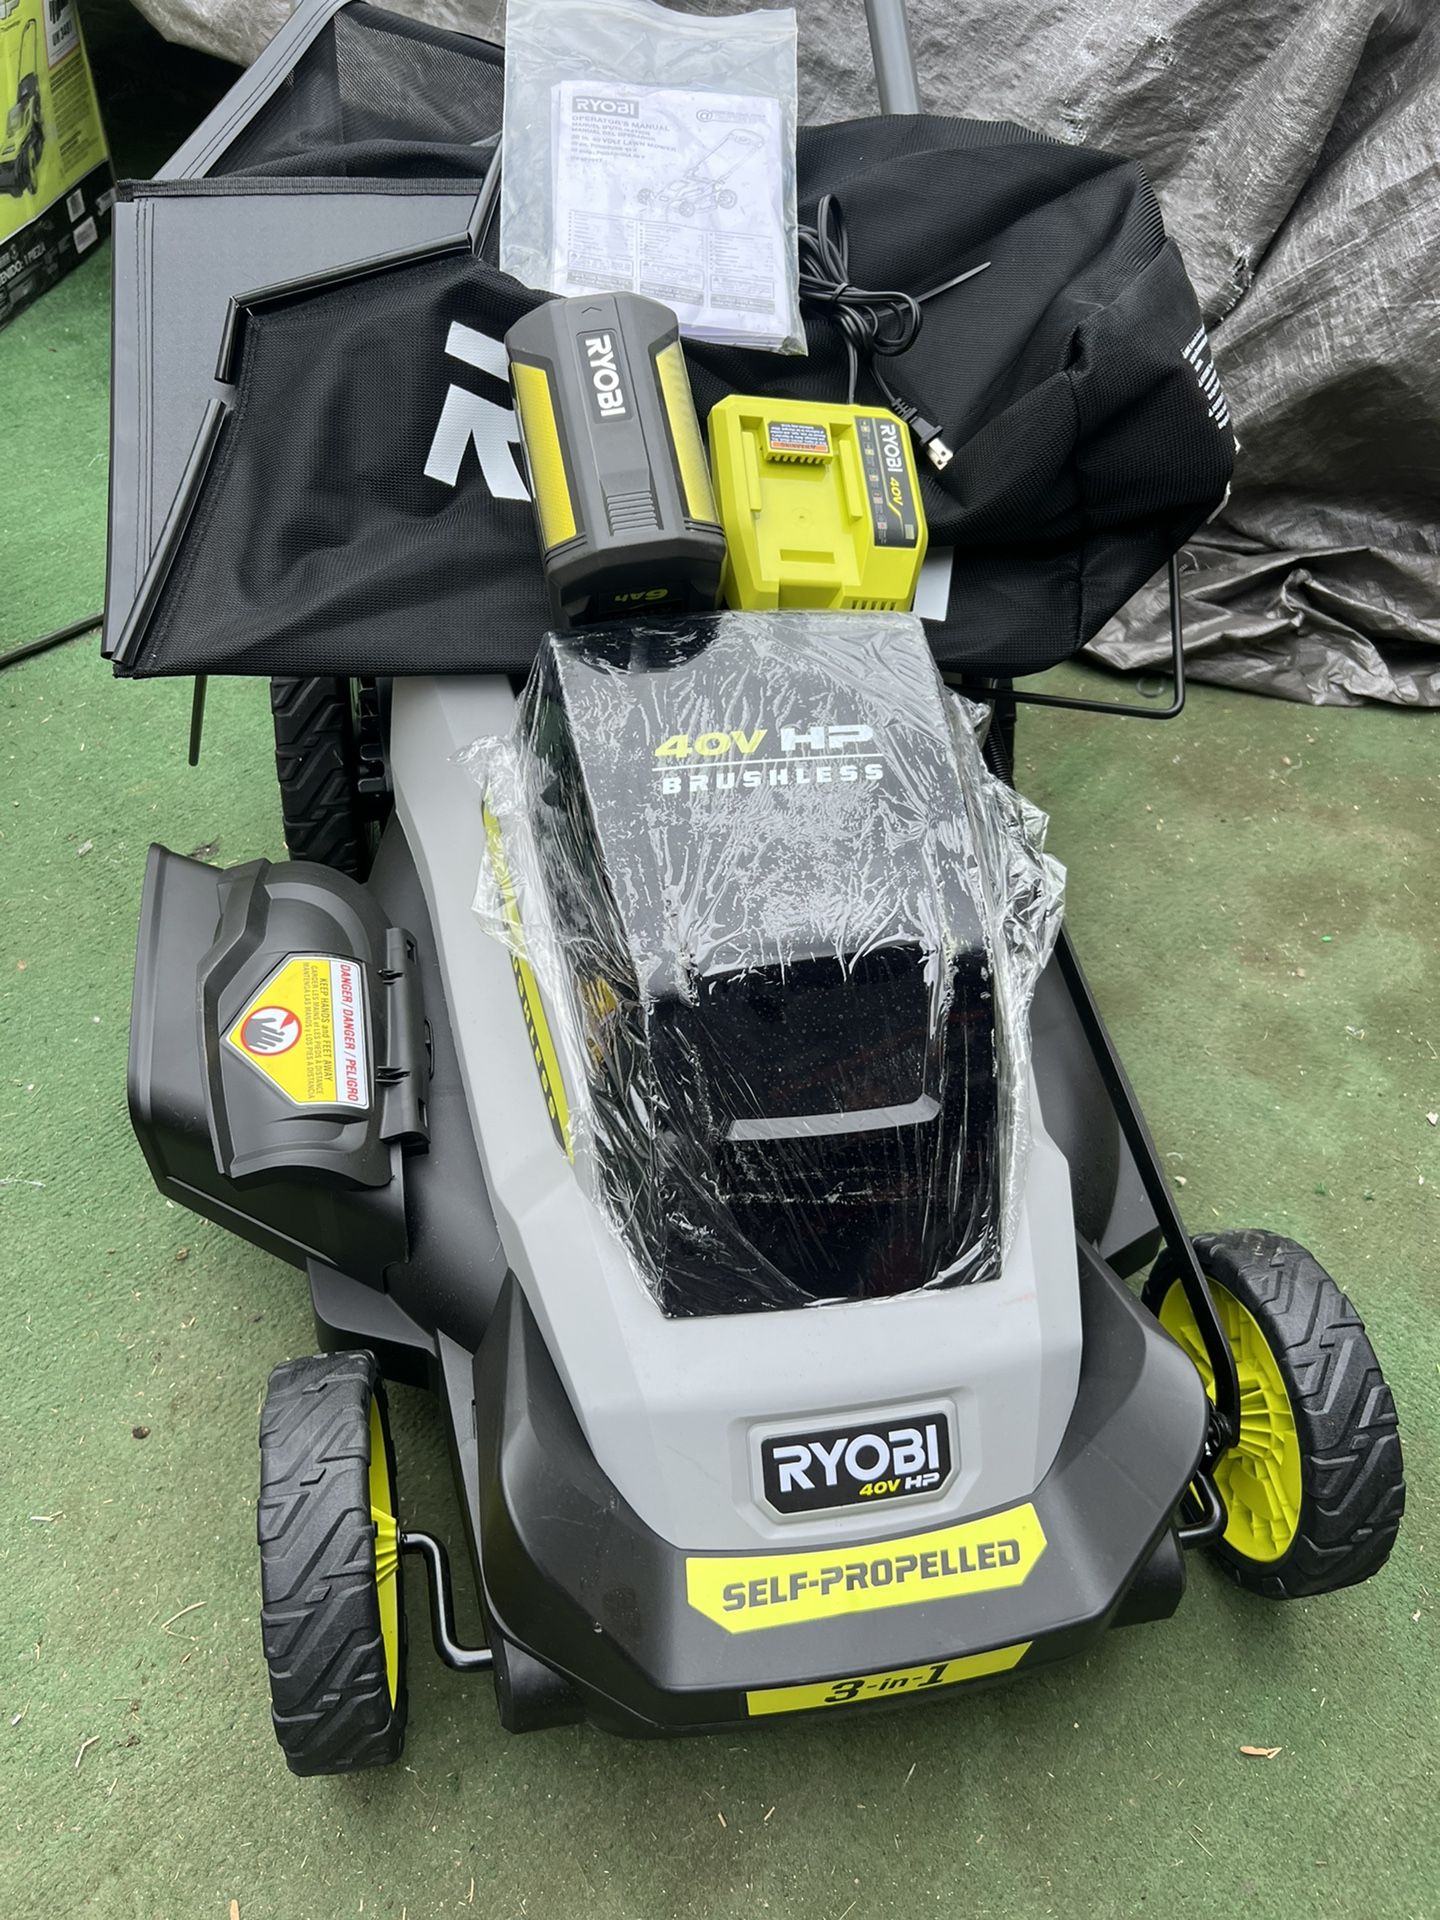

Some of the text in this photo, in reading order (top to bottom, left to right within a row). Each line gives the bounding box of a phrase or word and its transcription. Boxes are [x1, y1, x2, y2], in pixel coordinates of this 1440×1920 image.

[575, 98, 635, 116] RYOBI
[632, 122, 670, 132] MANUAL
[585, 334, 627, 417] RYOBI
[880, 424, 904, 507] RYOBI 40V
[613, 588, 669, 602] 6Ah
[654, 724, 874, 759] 40V HP
[662, 763, 884, 795] BRUSHLESS
[340, 964, 353, 1003] DANGER
[320, 977, 333, 1082] KEEP HANDS and FEET AWAY
[343, 1009, 356, 1050] DANGER
[315, 1065, 324, 1095] DISTANCE
[345, 1058, 359, 1102] PELIGRO
[773, 1424, 940, 1493] RYOBI
[858, 1472, 940, 1497] 40V HP
[722, 1538, 1021, 1612] SELF-PROPELLED
[824, 1663, 949, 1703] 3-in-1
